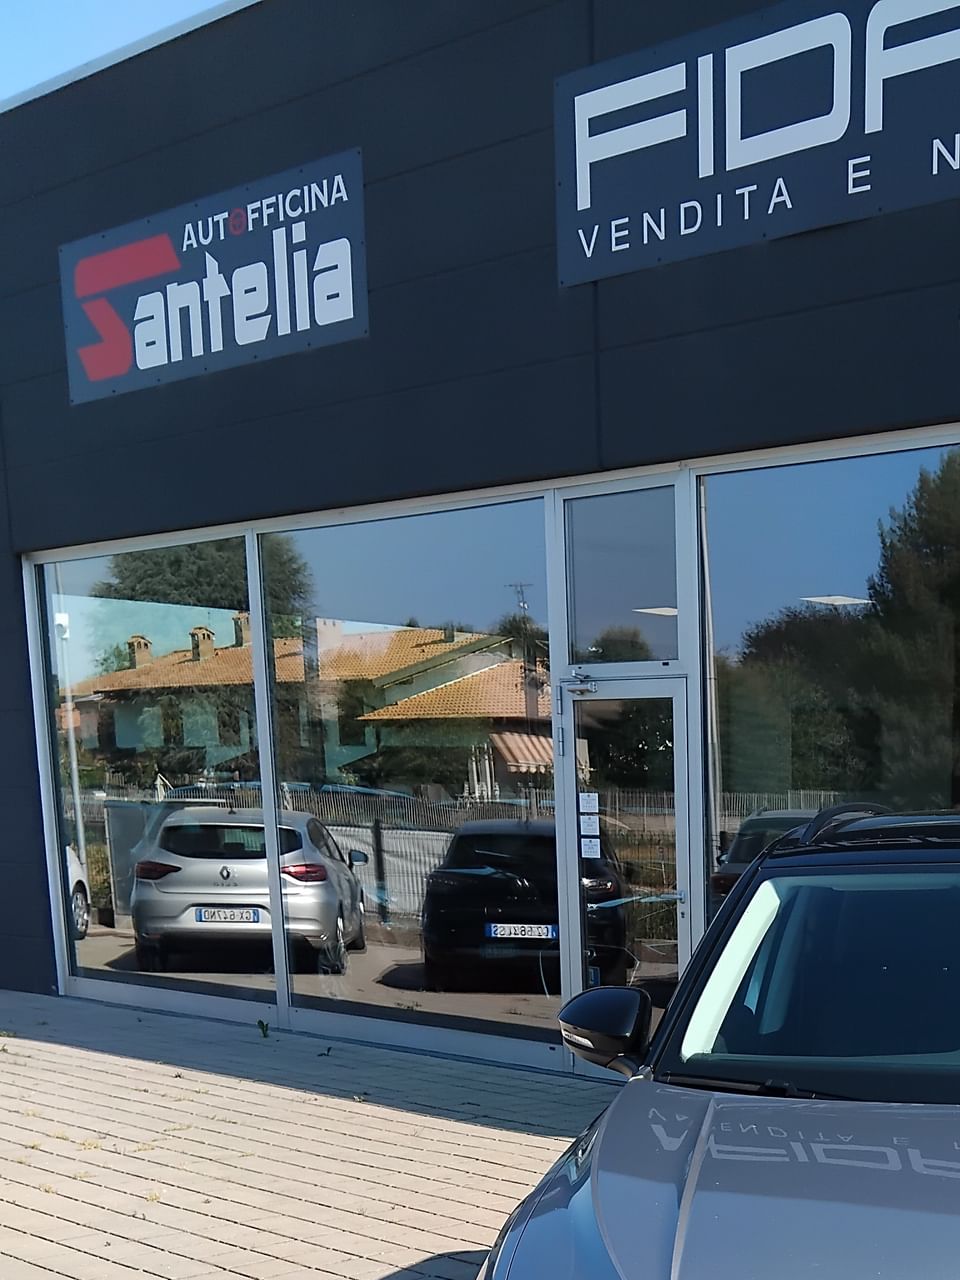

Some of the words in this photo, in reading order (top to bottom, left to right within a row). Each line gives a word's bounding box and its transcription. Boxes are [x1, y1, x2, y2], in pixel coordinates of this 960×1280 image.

[182, 174, 349, 252] AUTOFFICINA
[577, 177, 793, 259] VENDITA
[848, 155, 872, 195] E
[74, 221, 355, 382] Santelia
